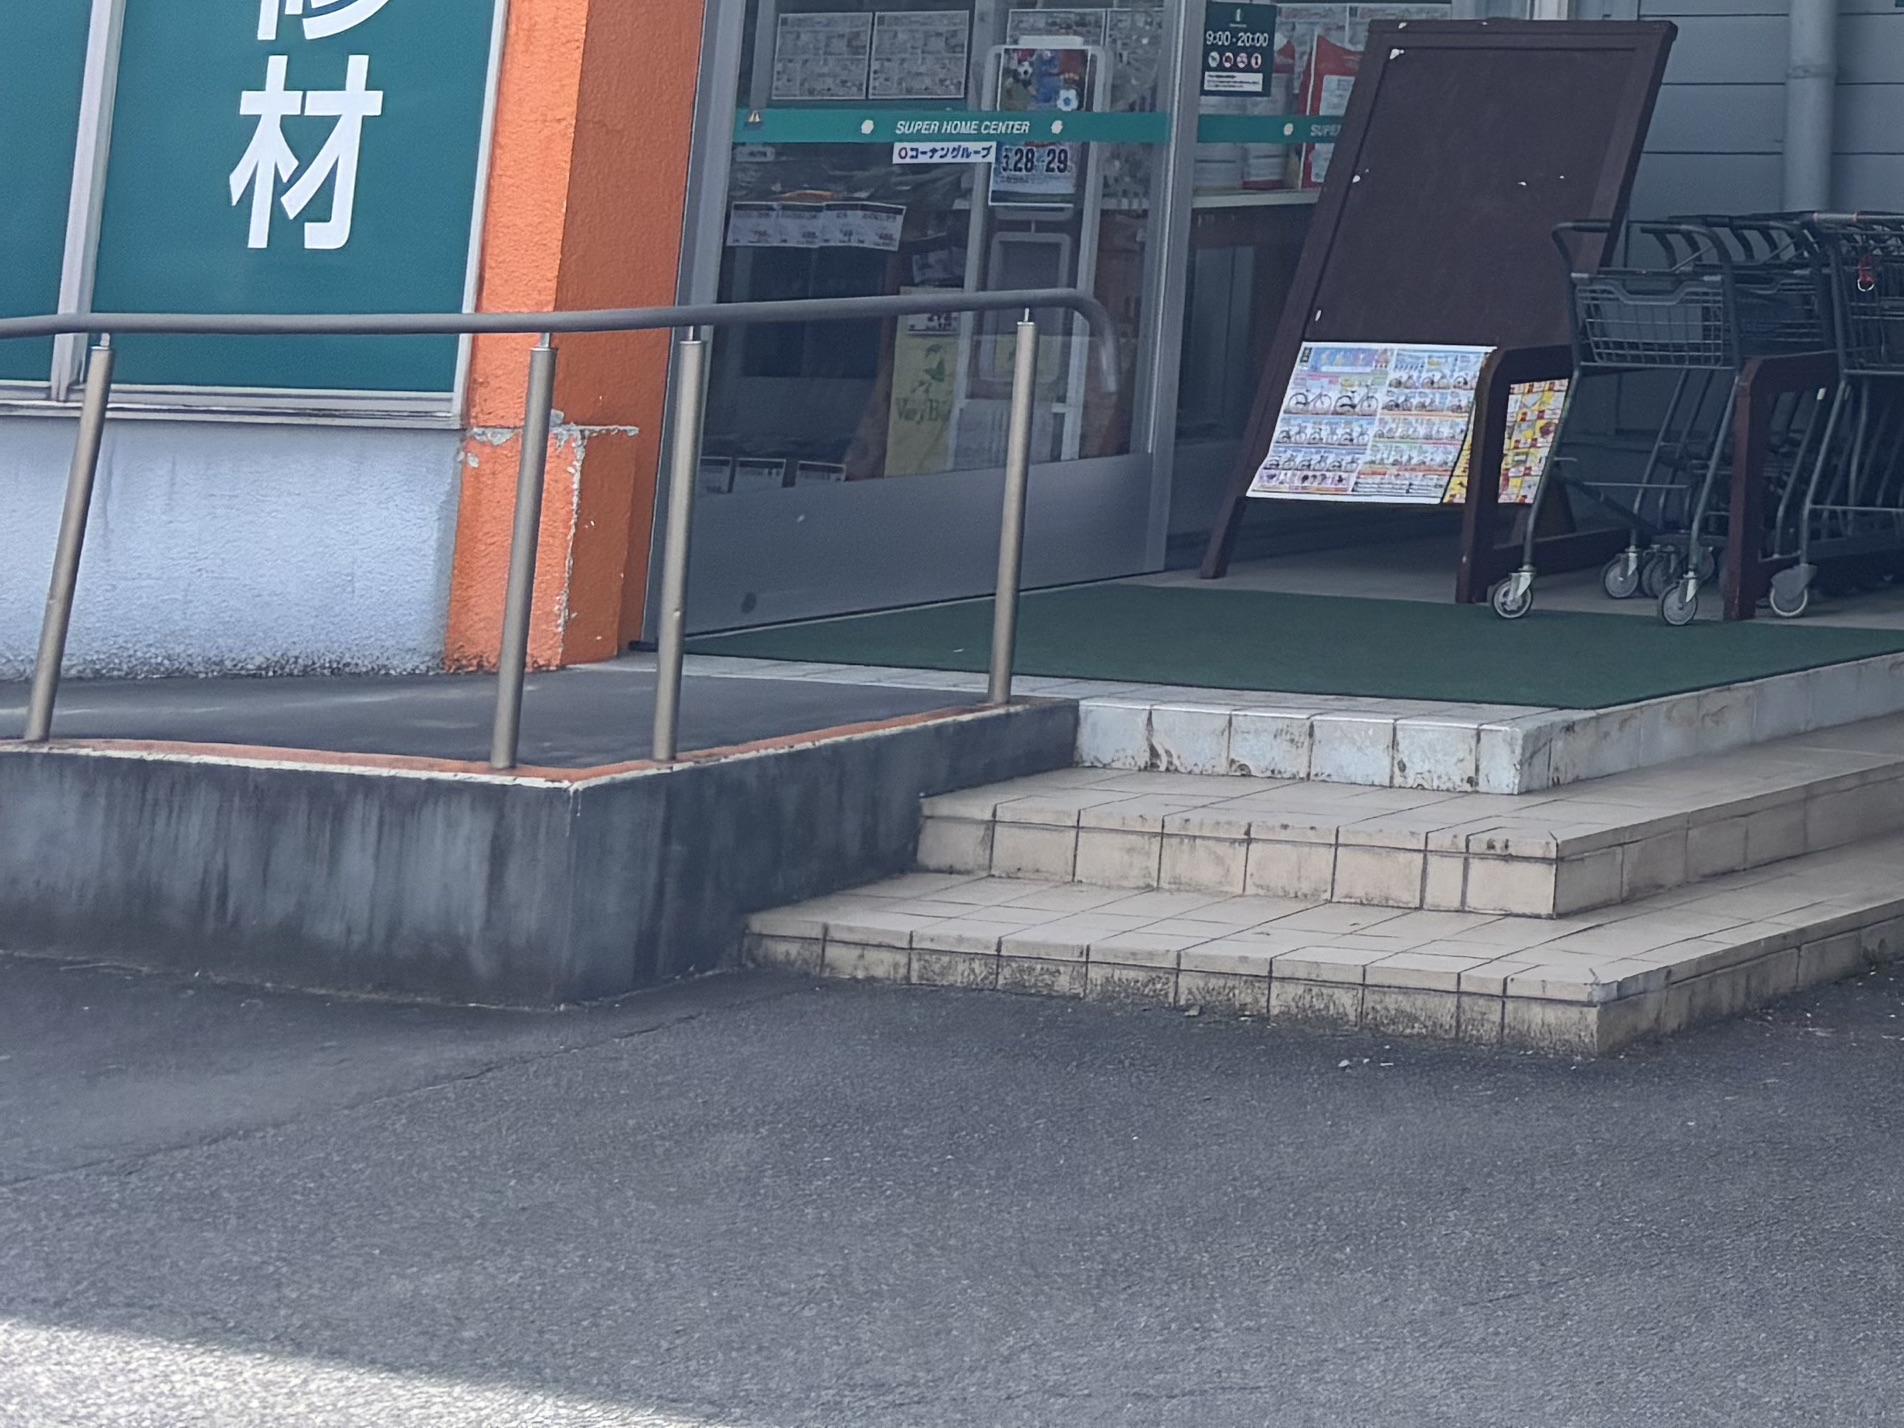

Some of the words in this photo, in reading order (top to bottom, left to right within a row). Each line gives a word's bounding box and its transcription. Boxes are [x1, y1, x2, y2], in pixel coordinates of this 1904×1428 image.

[895, 121, 938, 134] SUPER
[941, 121, 979, 134] HOME
[981, 120, 1030, 134] CENTER
